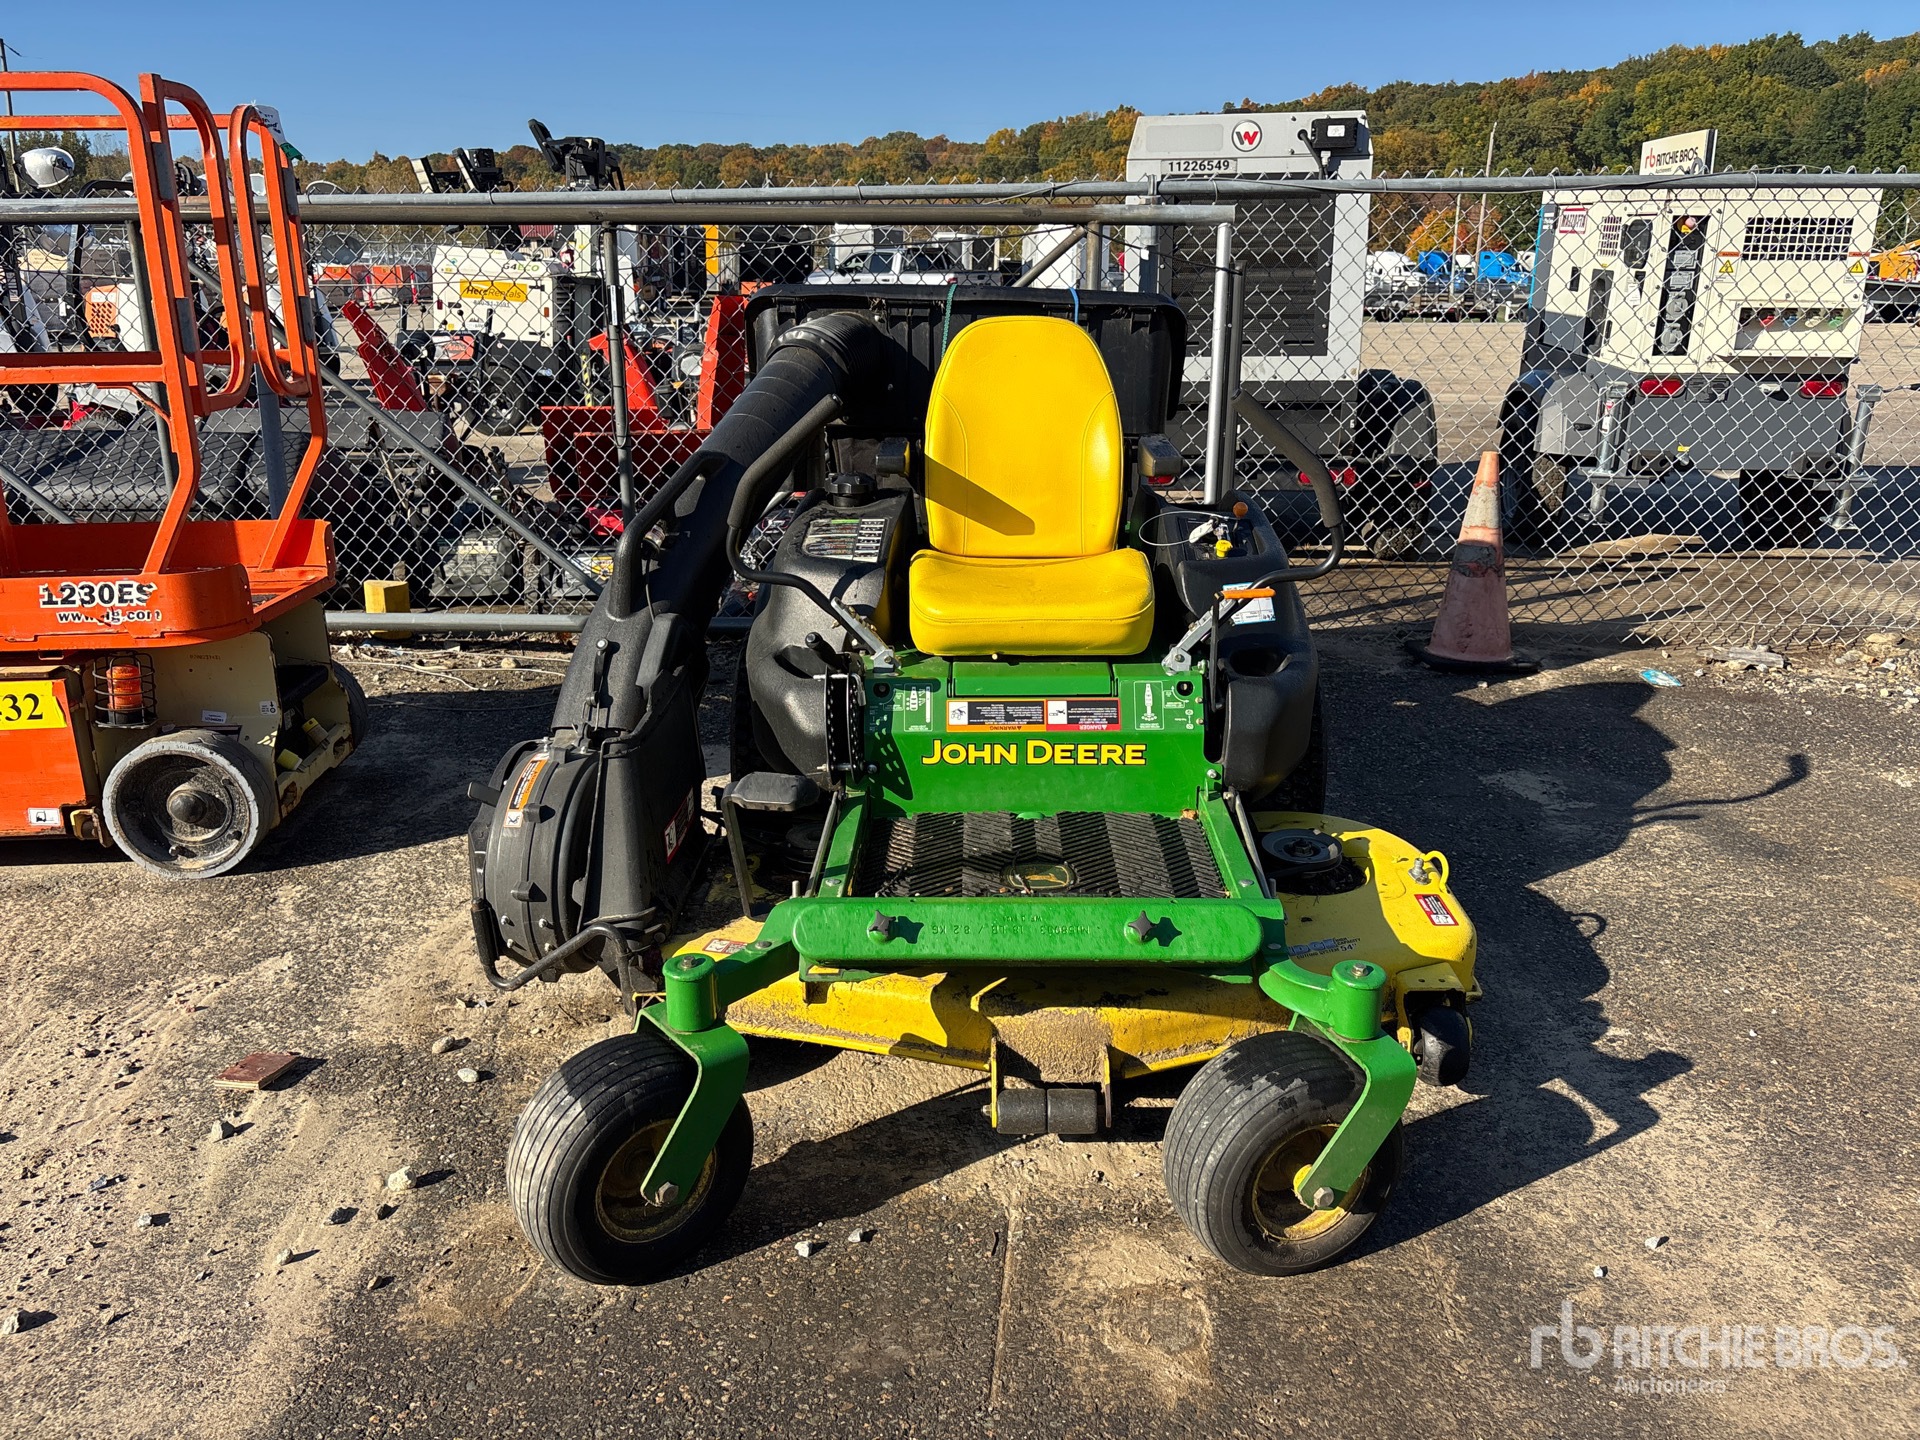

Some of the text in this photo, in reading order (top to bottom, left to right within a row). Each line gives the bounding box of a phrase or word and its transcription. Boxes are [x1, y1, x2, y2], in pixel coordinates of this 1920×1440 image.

[1167, 160, 1230, 172] 11226549
[1656, 150, 1679, 167] RITCHIE
[41, 582, 155, 606] 1230ES
[0, 693, 43, 721] 32
[922, 739, 1146, 766] JOHN DEERE
[931, 925, 946, 934] KG
[953, 925, 970, 934] 8.2
